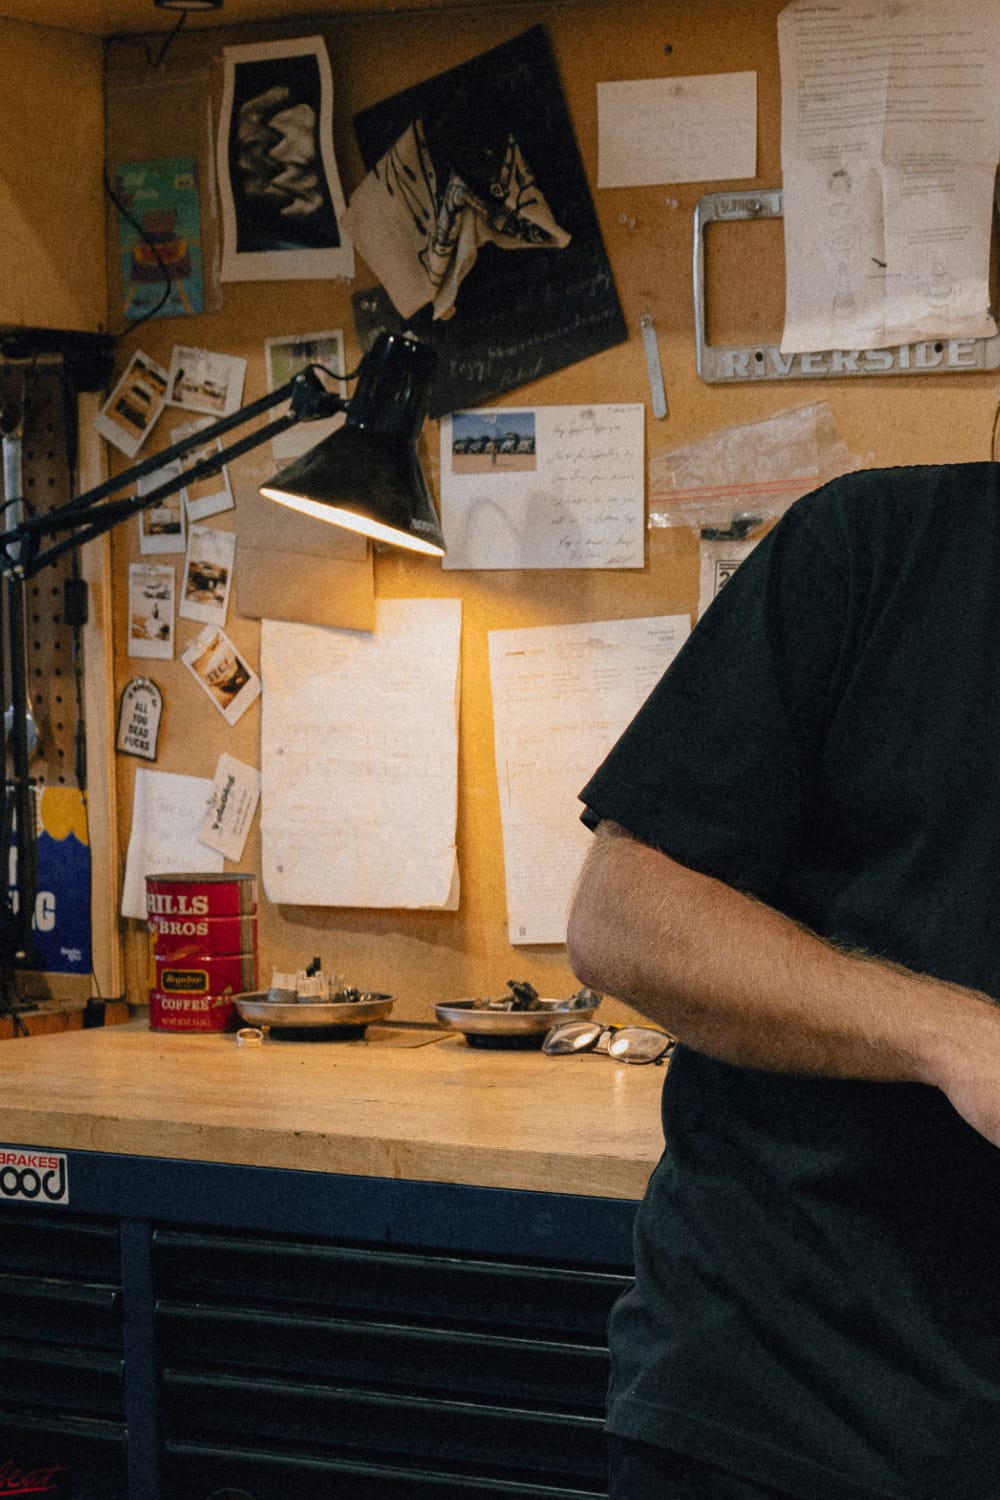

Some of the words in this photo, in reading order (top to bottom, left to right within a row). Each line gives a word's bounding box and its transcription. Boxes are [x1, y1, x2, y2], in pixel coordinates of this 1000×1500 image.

[720, 338, 978, 378] RIVERSIDE
[134, 702, 148, 714] ALL
[132, 713, 148, 726] YOU
[128, 725, 149, 738] DEAD
[124, 736, 150, 751] FUCKS
[147, 893, 209, 915] HILLS
[159, 921, 209, 937] BROS
[161, 999, 210, 1011] COFFEE
